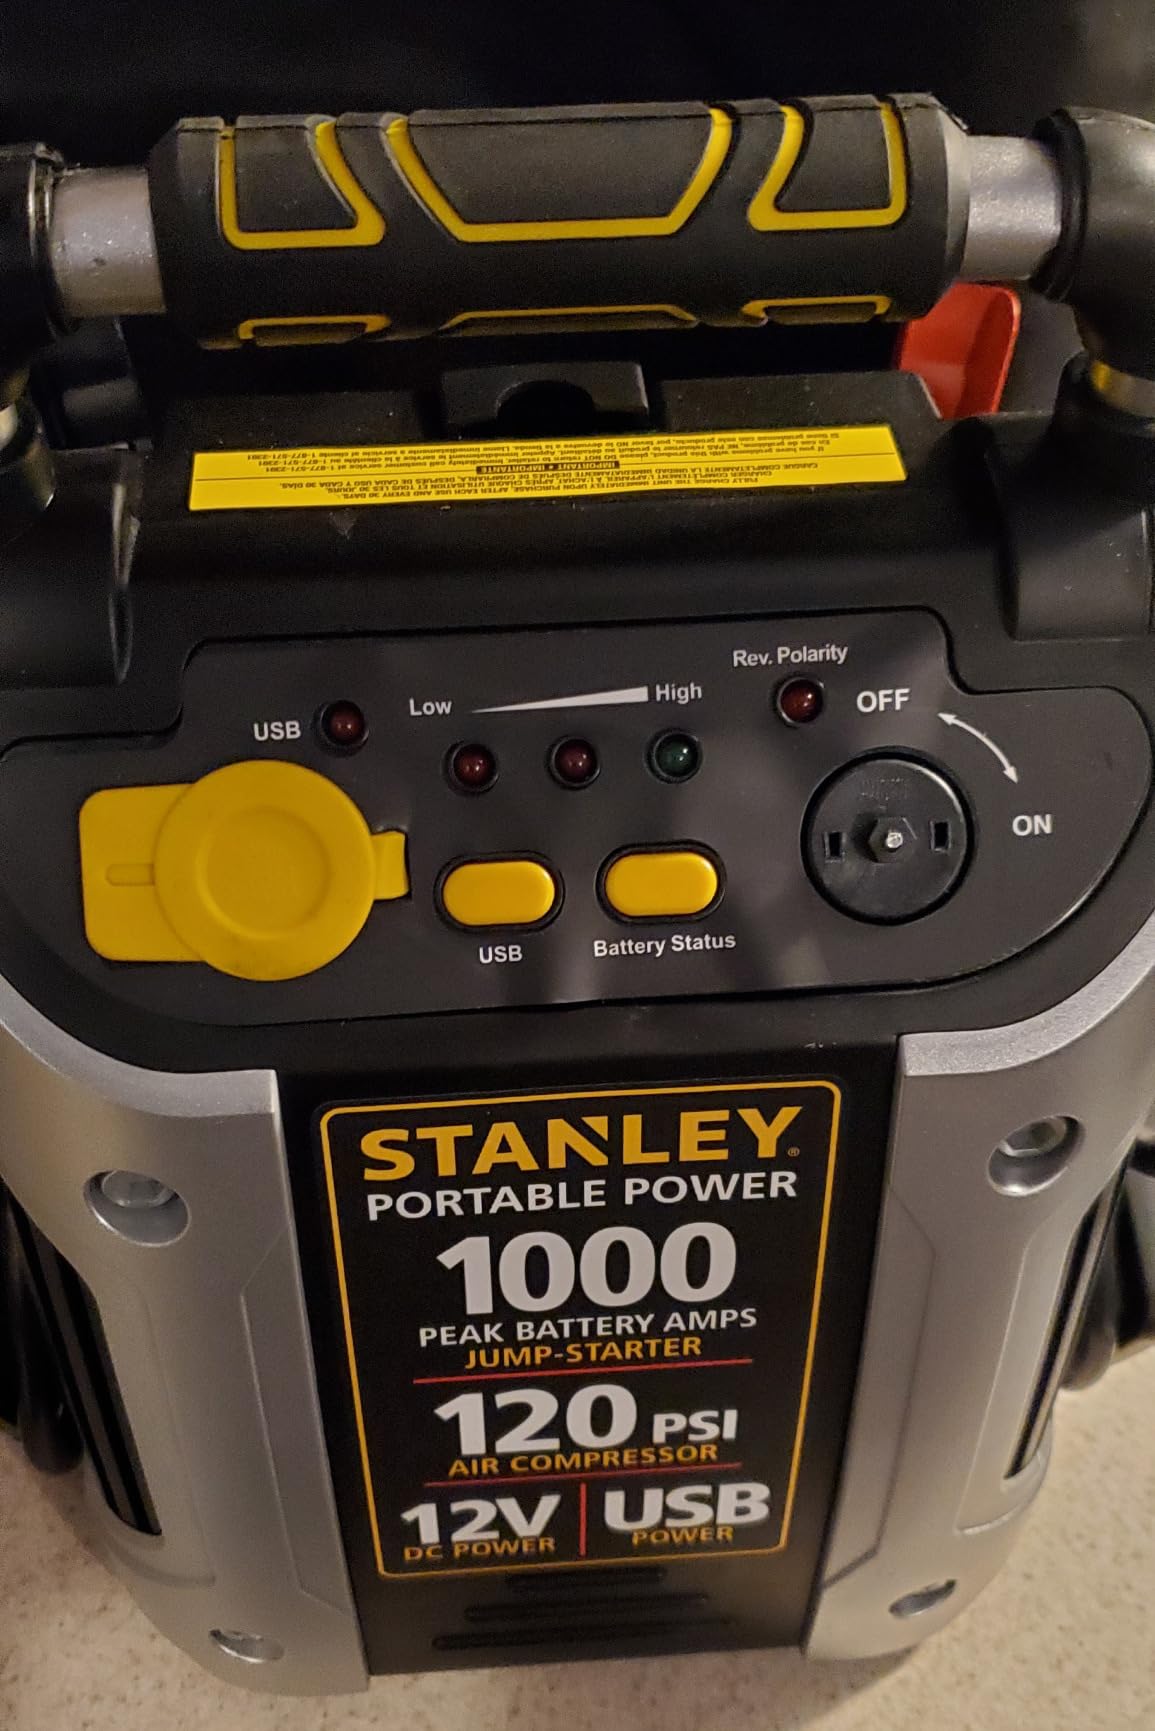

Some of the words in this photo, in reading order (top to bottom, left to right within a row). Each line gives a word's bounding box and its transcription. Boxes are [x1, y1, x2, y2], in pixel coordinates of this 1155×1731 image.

[481, 464, 545, 473] IMPORTANTE
[557, 462, 615, 470] IMPORTANT
[732, 647, 773, 668] Rev.
[777, 640, 849, 668] Polarity
[408, 696, 453, 718] Low
[654, 681, 704, 705] High
[855, 688, 912, 714] OFF
[253, 719, 302, 742] USB
[1011, 814, 1054, 838] ON
[477, 943, 523, 965] USB
[592, 935, 665, 960] Battery
[670, 930, 737, 955] Status
[359, 1105, 802, 1182] STANLEY
[366, 1179, 606, 1221] PORTABLE
[625, 1171, 798, 1205] POWER
[436, 1221, 737, 1315] 1000
[419, 1322, 505, 1347] PEAK
[517, 1313, 655, 1341] BATTERY
[664, 1308, 758, 1330] AMPS
[464, 1336, 702, 1369] JUMP-STARTER
[433, 1384, 638, 1455] 120
[652, 1409, 738, 1443] PSI
[448, 1456, 499, 1477] AIR
[510, 1444, 718, 1472] COMPRESSOR
[401, 1494, 561, 1546] 12V
[604, 1482, 770, 1532] USB
[404, 1542, 443, 1561] DC
[453, 1536, 555, 1558] POWER
[632, 1526, 734, 1546] POWER
